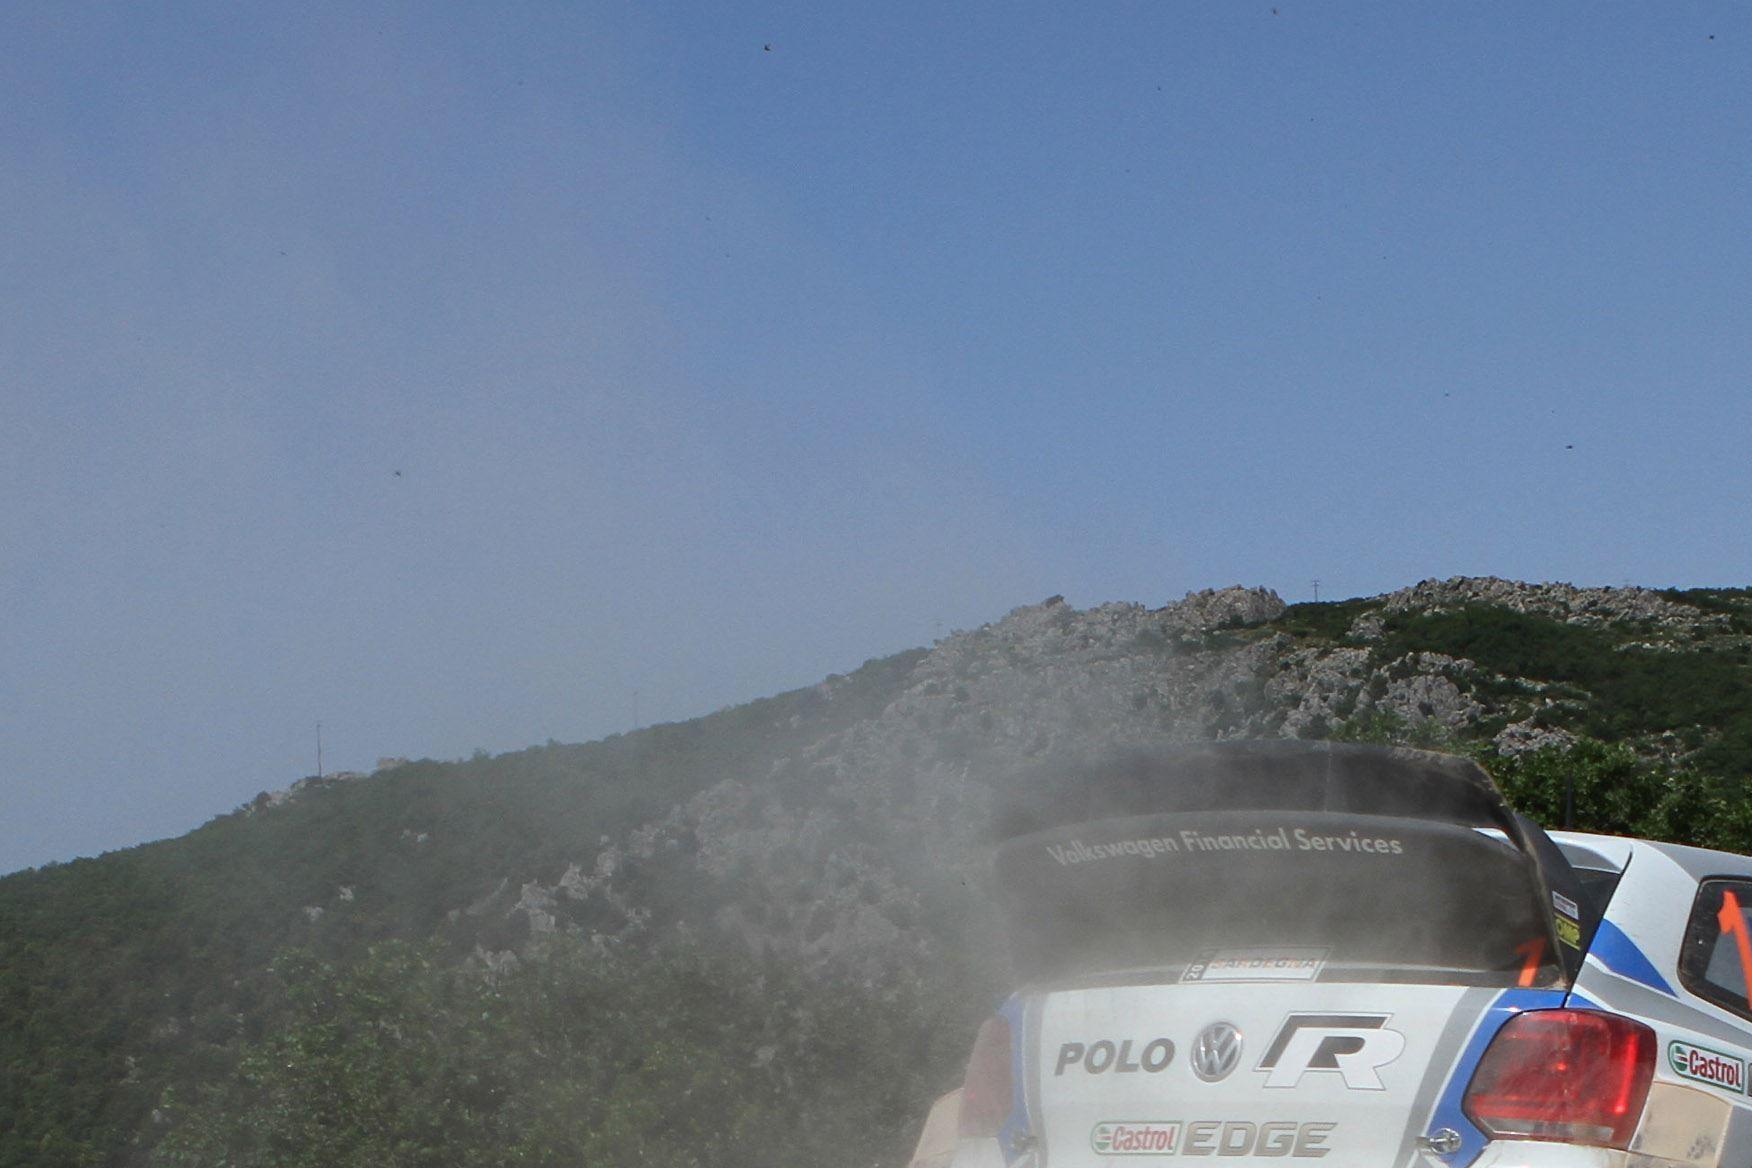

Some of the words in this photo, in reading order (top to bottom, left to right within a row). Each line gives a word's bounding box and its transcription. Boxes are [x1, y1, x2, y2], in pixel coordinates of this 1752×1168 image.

[1046, 836, 1180, 866] Volkswagen
[1180, 828, 1290, 852] Financial
[1293, 829, 1403, 854] Services
[1517, 936, 1546, 987] 1
[1054, 1038, 1176, 1076] POLO
[1252, 1011, 1407, 1091] R
[1689, 1050, 1741, 1088] Castrol
[1112, 1125, 1175, 1151] Castrol
[1181, 1120, 1339, 1157] EDGE
